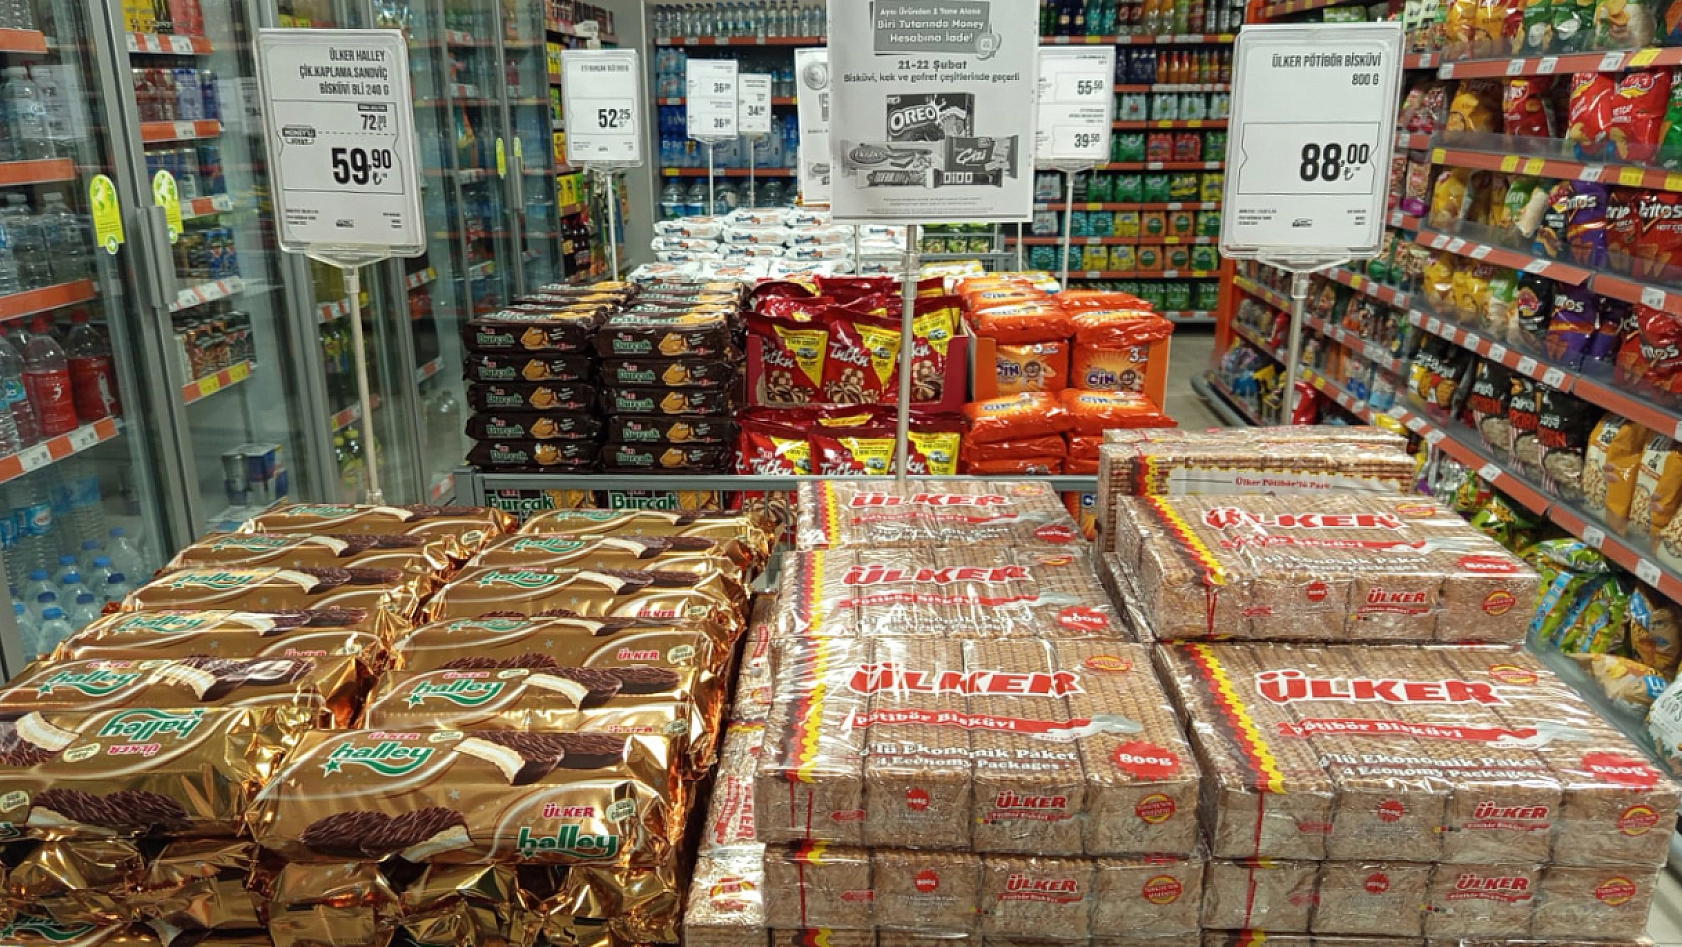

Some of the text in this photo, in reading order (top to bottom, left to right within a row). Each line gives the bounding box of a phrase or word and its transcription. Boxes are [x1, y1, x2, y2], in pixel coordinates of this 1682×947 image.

[899, 19, 950, 29] Tutarında
[952, 19, 984, 30] Money
[890, 32, 942, 42] Hesabına
[329, 46, 385, 62] ÜLKER HALLEY
[1271, 53, 1302, 67] ÜLKER
[1344, 52, 1382, 67] BİSKÜVİ
[897, 60, 968, 72] 21-22 Şubat
[880, 72, 895, 81] kek
[1351, 73, 1370, 85] 800
[319, 82, 351, 95] BİSKÜVİ
[889, 107, 937, 130] OREO
[482, 570, 558, 588] halley
[842, 564, 1034, 586] ÜLKER
[1366, 587, 1426, 604] ÜLKER
[618, 648, 660, 661] ÜLKER
[49, 671, 140, 694] halley
[848, 662, 1086, 699] ÜLKER
[1254, 667, 1511, 707] ÜLKER
[413, 677, 505, 706] halley
[96, 709, 200, 742] halley
[330, 741, 436, 776] halley
[1016, 749, 1078, 761] Paket
[996, 790, 1067, 810] ÜLKER
[543, 801, 595, 818] ÜLKER
[1473, 801, 1550, 820] ÜLKER
[517, 824, 619, 858] halley
[1006, 874, 1078, 894] ÜLKER
[1455, 873, 1530, 891] ÜLKER
